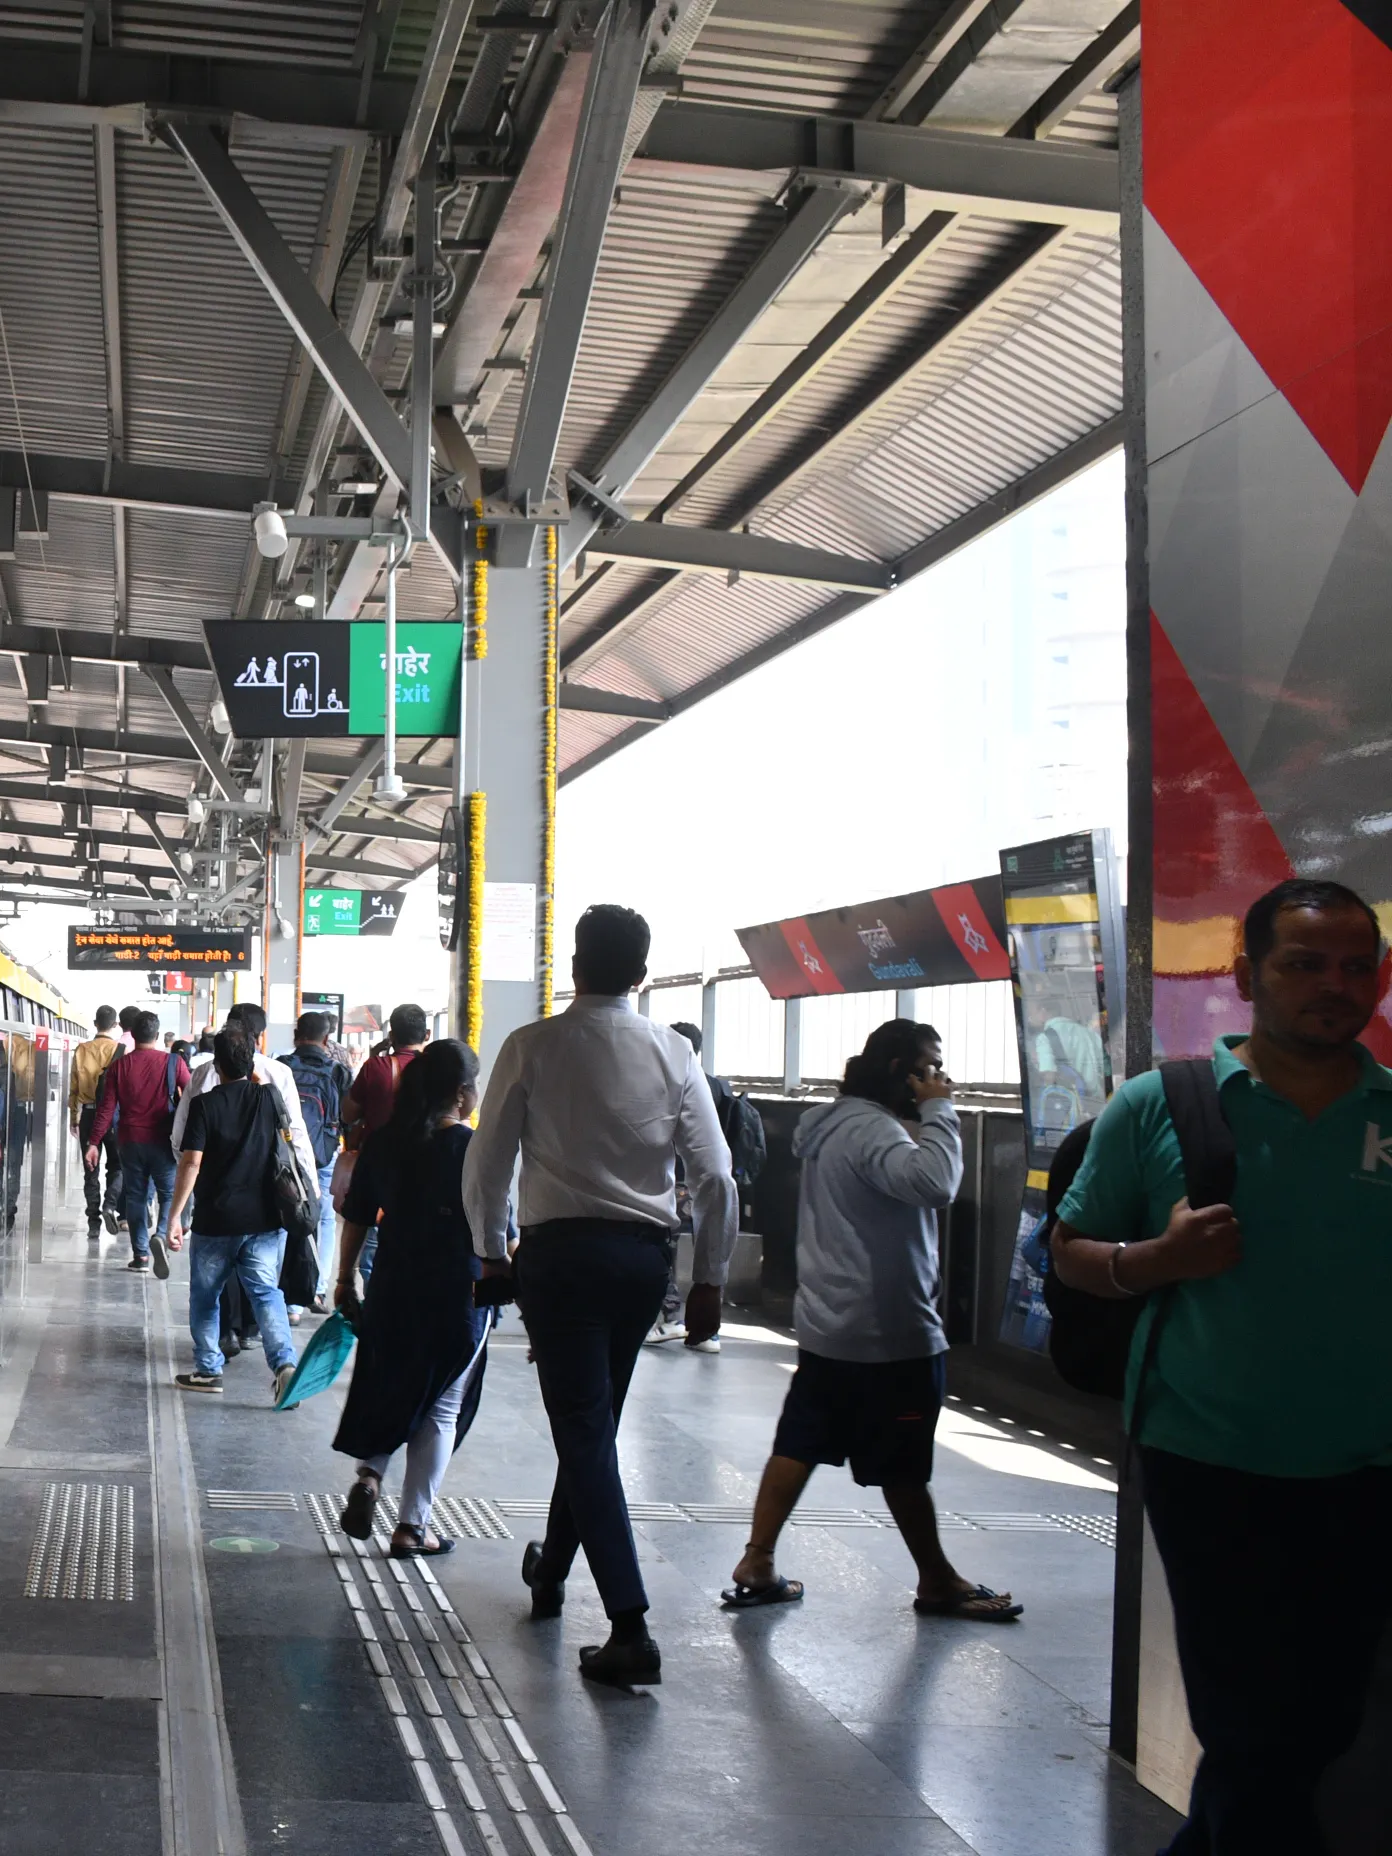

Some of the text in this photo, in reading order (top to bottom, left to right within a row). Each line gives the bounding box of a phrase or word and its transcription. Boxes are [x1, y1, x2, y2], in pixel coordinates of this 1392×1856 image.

[395, 683, 430, 702] Exit
[332, 897, 354, 910] बाहेर
[334, 912, 353, 921] Exit
[238, 952, 245, 960] 6
[868, 956, 924, 980] Gundavali
[174, 976, 183, 989] 1
[38, 1036, 46, 1048] 7
